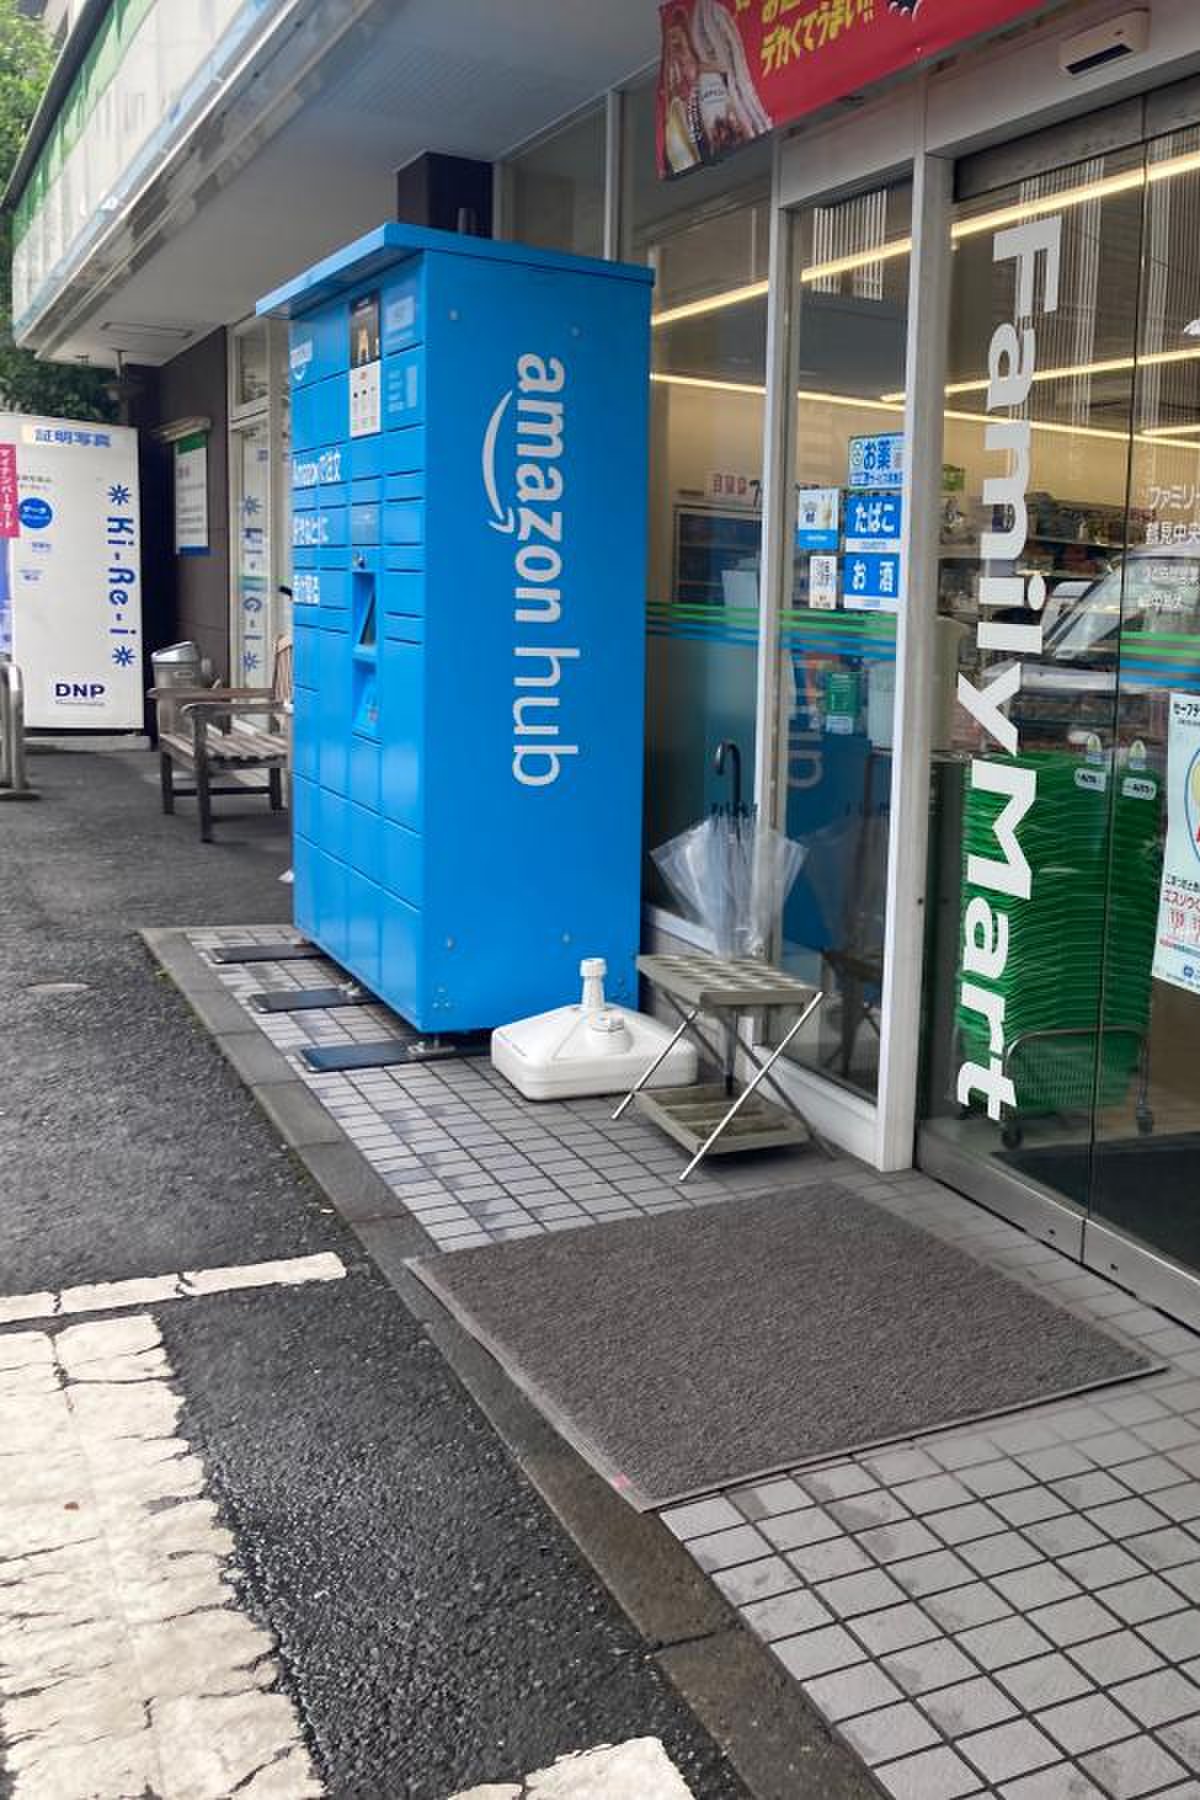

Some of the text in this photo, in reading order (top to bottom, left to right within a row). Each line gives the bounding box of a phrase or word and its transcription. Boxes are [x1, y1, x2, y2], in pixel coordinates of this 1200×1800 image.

[35, 428, 111, 448] 証明写真
[854, 501, 895, 533] たばこ
[512, 353, 580, 787] amazon hub
[957, 215, 1062, 1121] FamilyMart
[55, 682, 105, 698] DNP
